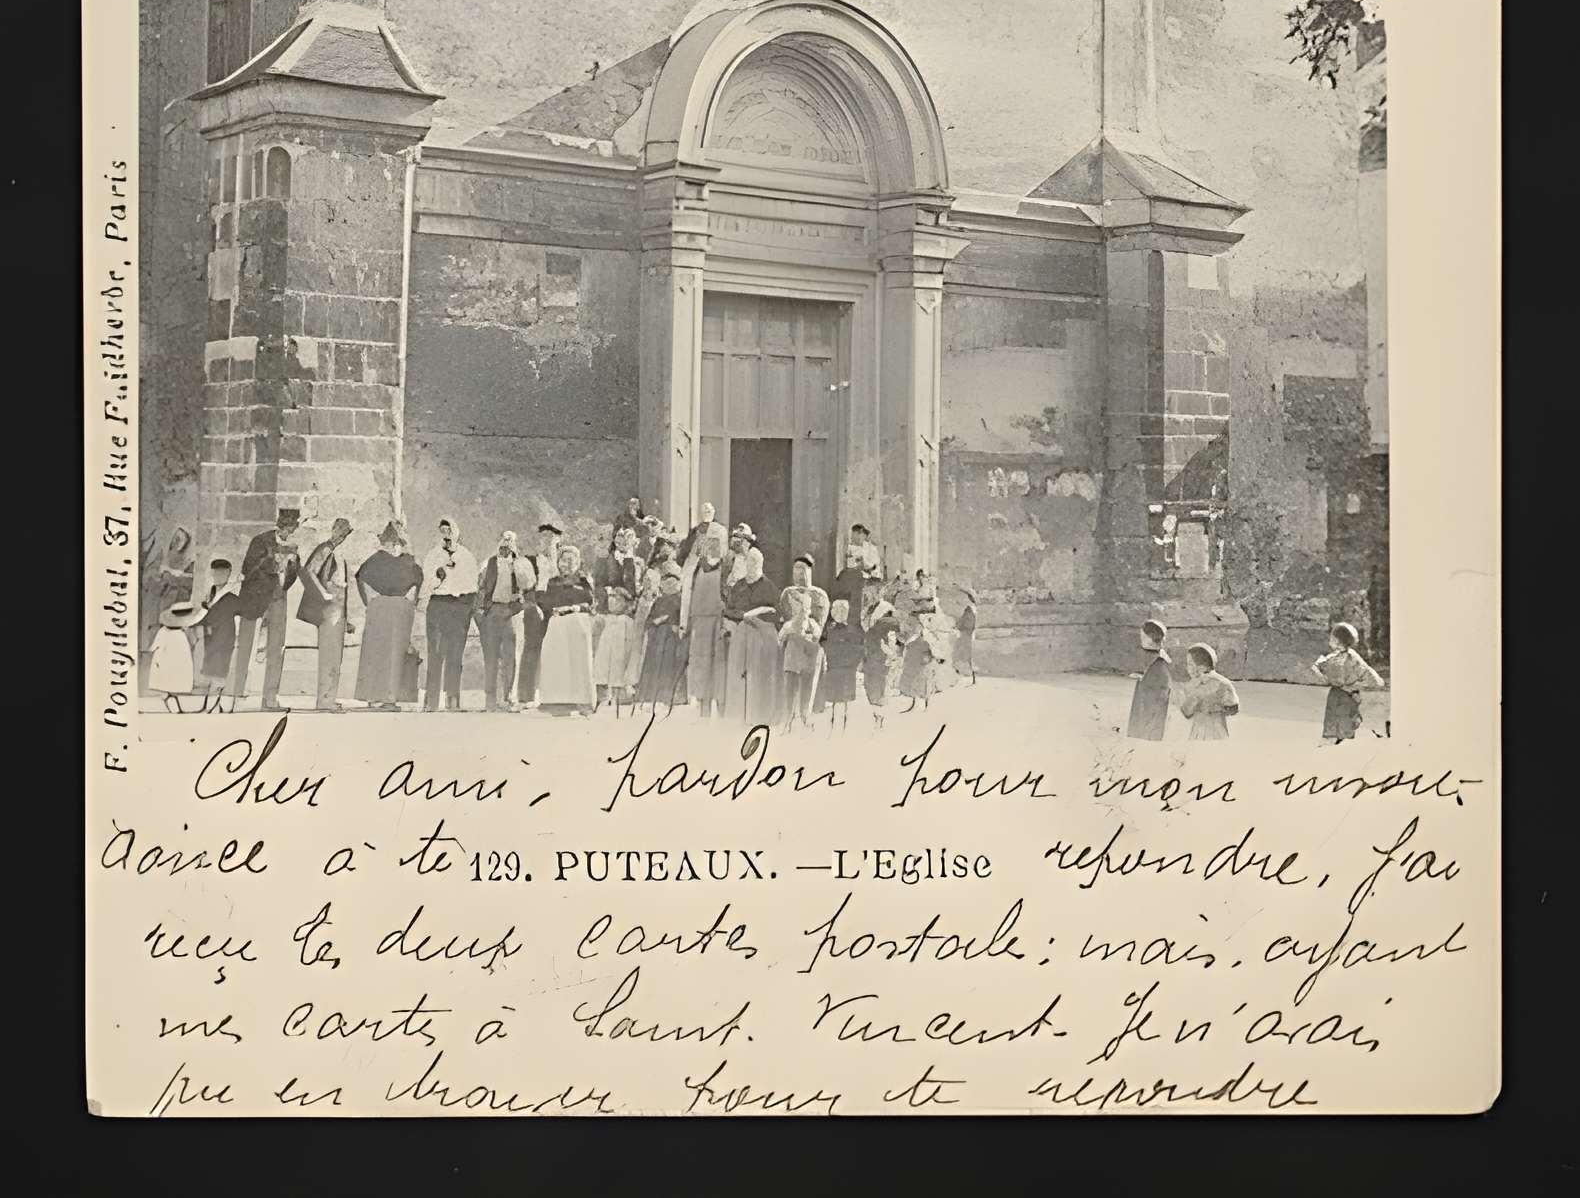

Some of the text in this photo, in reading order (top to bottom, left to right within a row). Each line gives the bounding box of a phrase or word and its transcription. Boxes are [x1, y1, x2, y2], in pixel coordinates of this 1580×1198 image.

[194, 710, 327, 806] Cher
[600, 711, 846, 812] pardon
[890, 723, 1057, 808] pour
[1089, 776, 1236, 803] mon
[323, 841, 376, 876] à
[399, 818, 466, 875] te
[376, 904, 523, 972] deux
[1264, 922, 1468, 1007] ayant
[474, 1005, 516, 1045] à
[274, 1077, 343, 1107] en
[682, 1059, 844, 1114] pour
[883, 1065, 967, 1108] te
